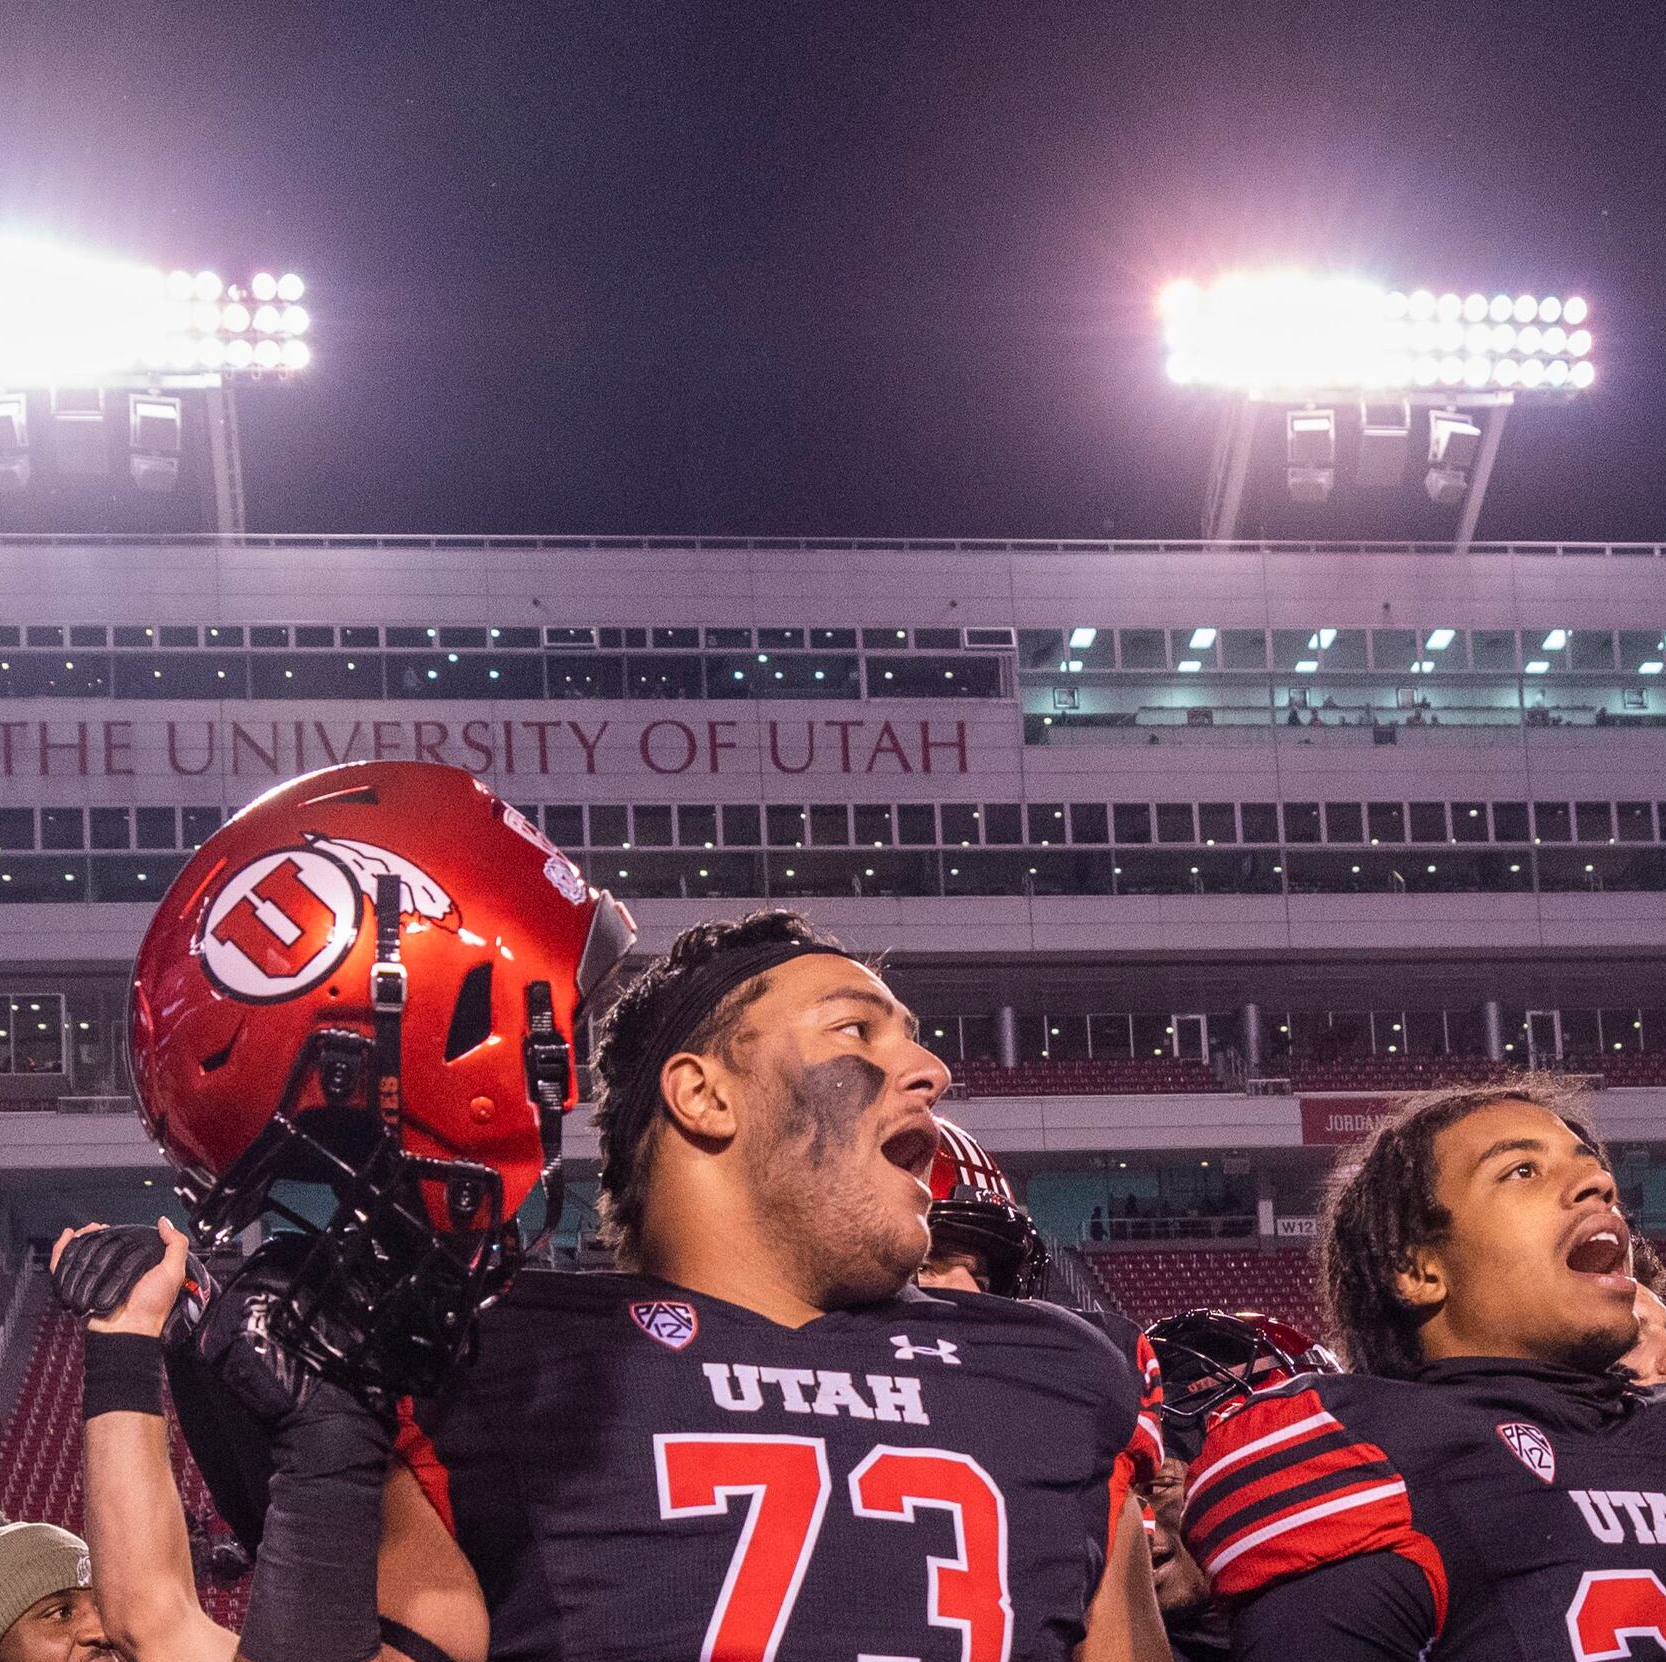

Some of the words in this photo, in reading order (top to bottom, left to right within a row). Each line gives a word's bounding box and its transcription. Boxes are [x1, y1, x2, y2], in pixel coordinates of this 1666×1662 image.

[167, 719, 610, 776] UNIVERSITY
[639, 719, 738, 774] OF
[769, 720, 970, 775] UTAH
[210, 856, 337, 979] U
[1283, 1220, 1313, 1234] W12
[635, 1300, 694, 1328] PAC
[654, 1322, 686, 1339] 12
[702, 1362, 930, 1425] UTAH
[1501, 1423, 1546, 1456] PAC
[1523, 1446, 1552, 1470] 12
